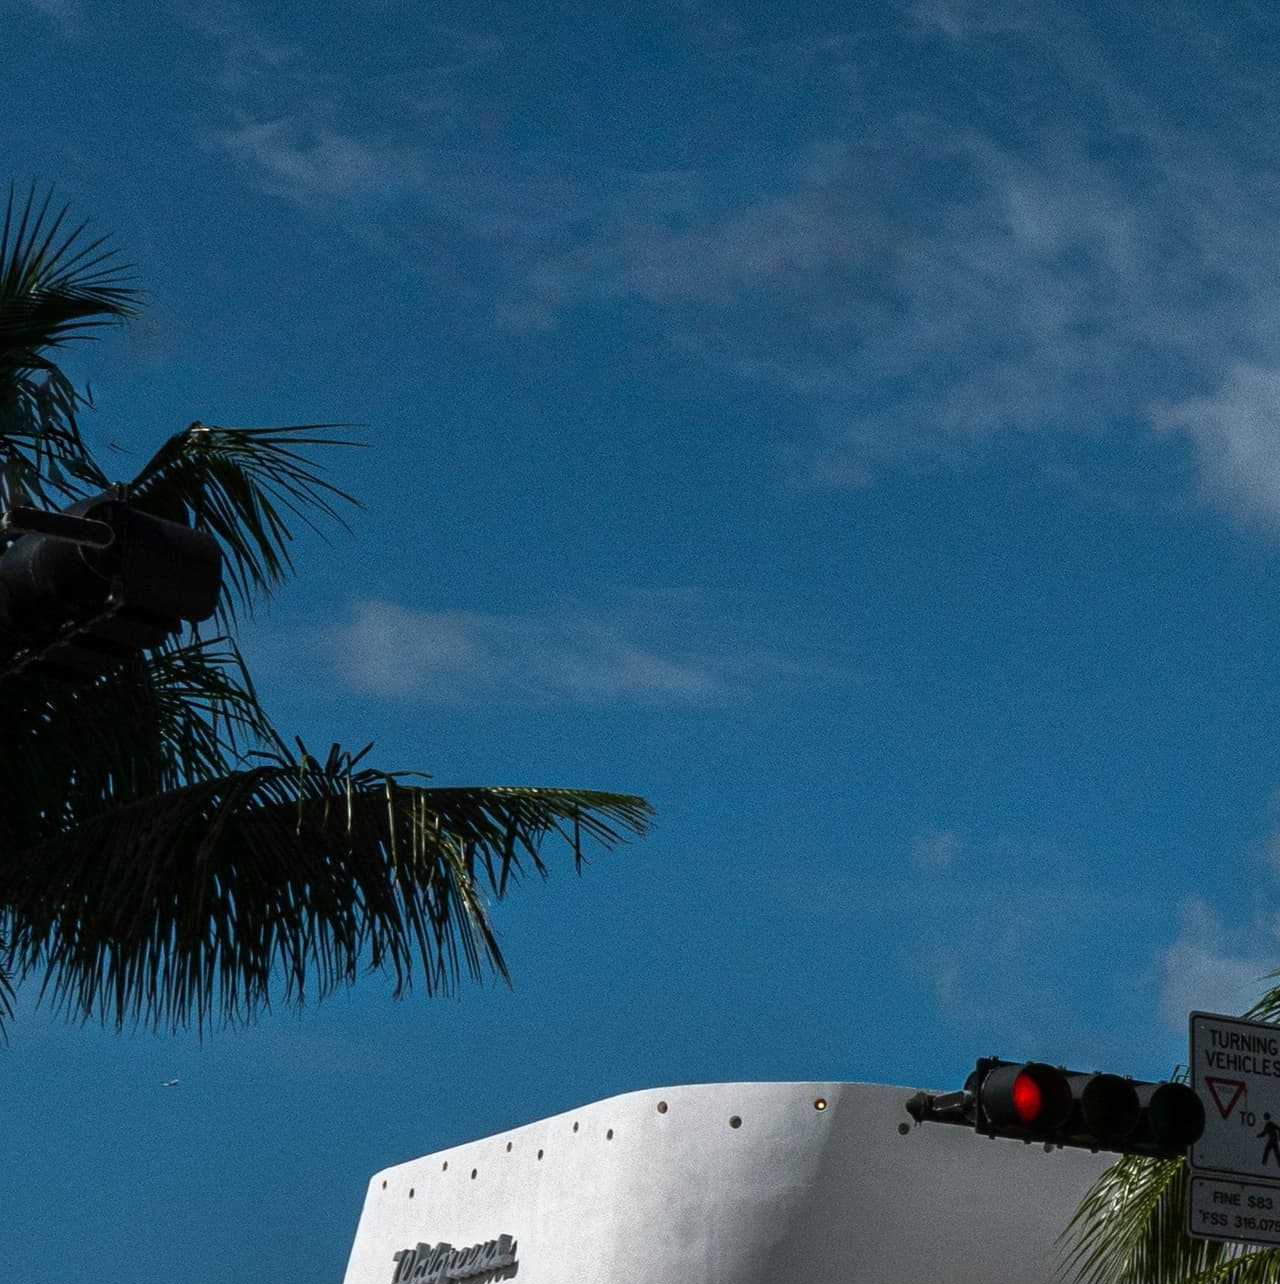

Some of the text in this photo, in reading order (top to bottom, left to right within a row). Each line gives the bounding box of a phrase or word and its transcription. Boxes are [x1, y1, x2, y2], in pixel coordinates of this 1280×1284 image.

[1209, 1029, 1279, 1057] TURNING
[1240, 1110, 1256, 1127] TO
[1213, 1191, 1241, 1208] FINE
